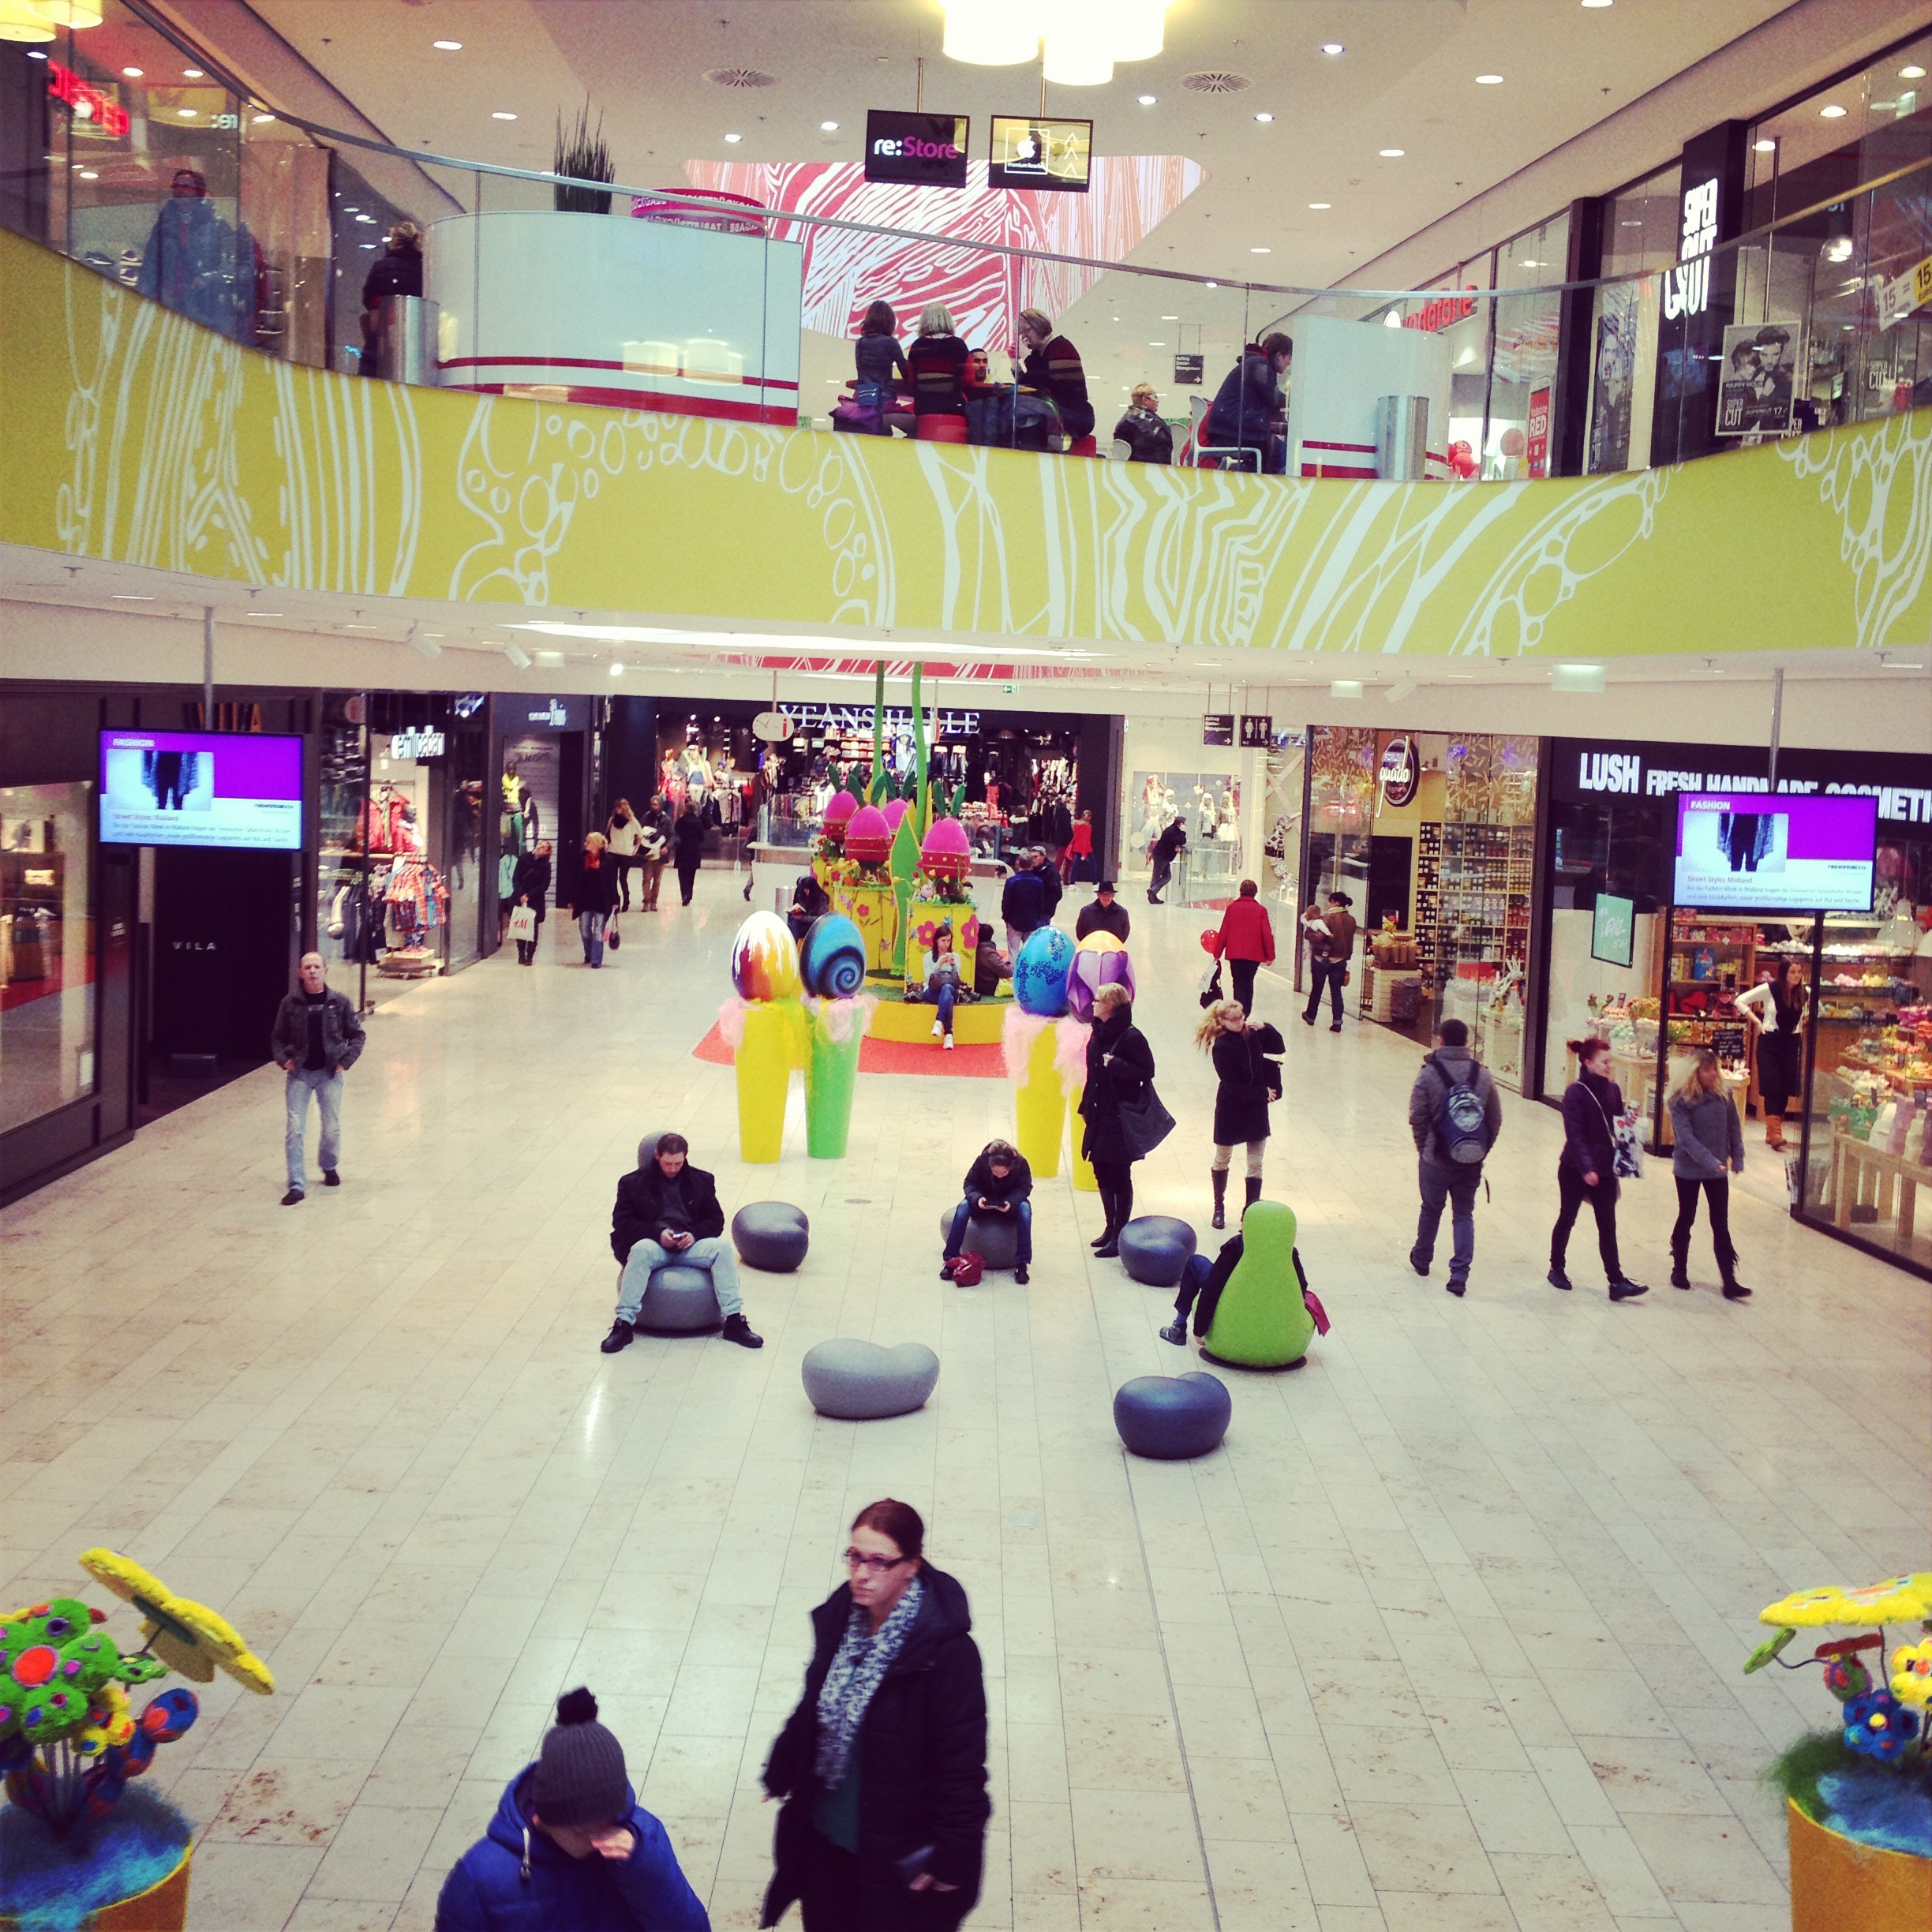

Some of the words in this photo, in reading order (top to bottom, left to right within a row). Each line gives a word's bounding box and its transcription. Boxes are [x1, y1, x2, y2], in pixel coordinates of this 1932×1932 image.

[874, 136, 957, 159] re:Store
[1529, 415, 1547, 437] RED
[1724, 408, 1743, 427] CUT
[1579, 752, 1641, 795] LUSH
[1646, 769, 1702, 797] FRESH
[1690, 799, 1731, 811] FASHION
[172, 942, 217, 951] VILA
